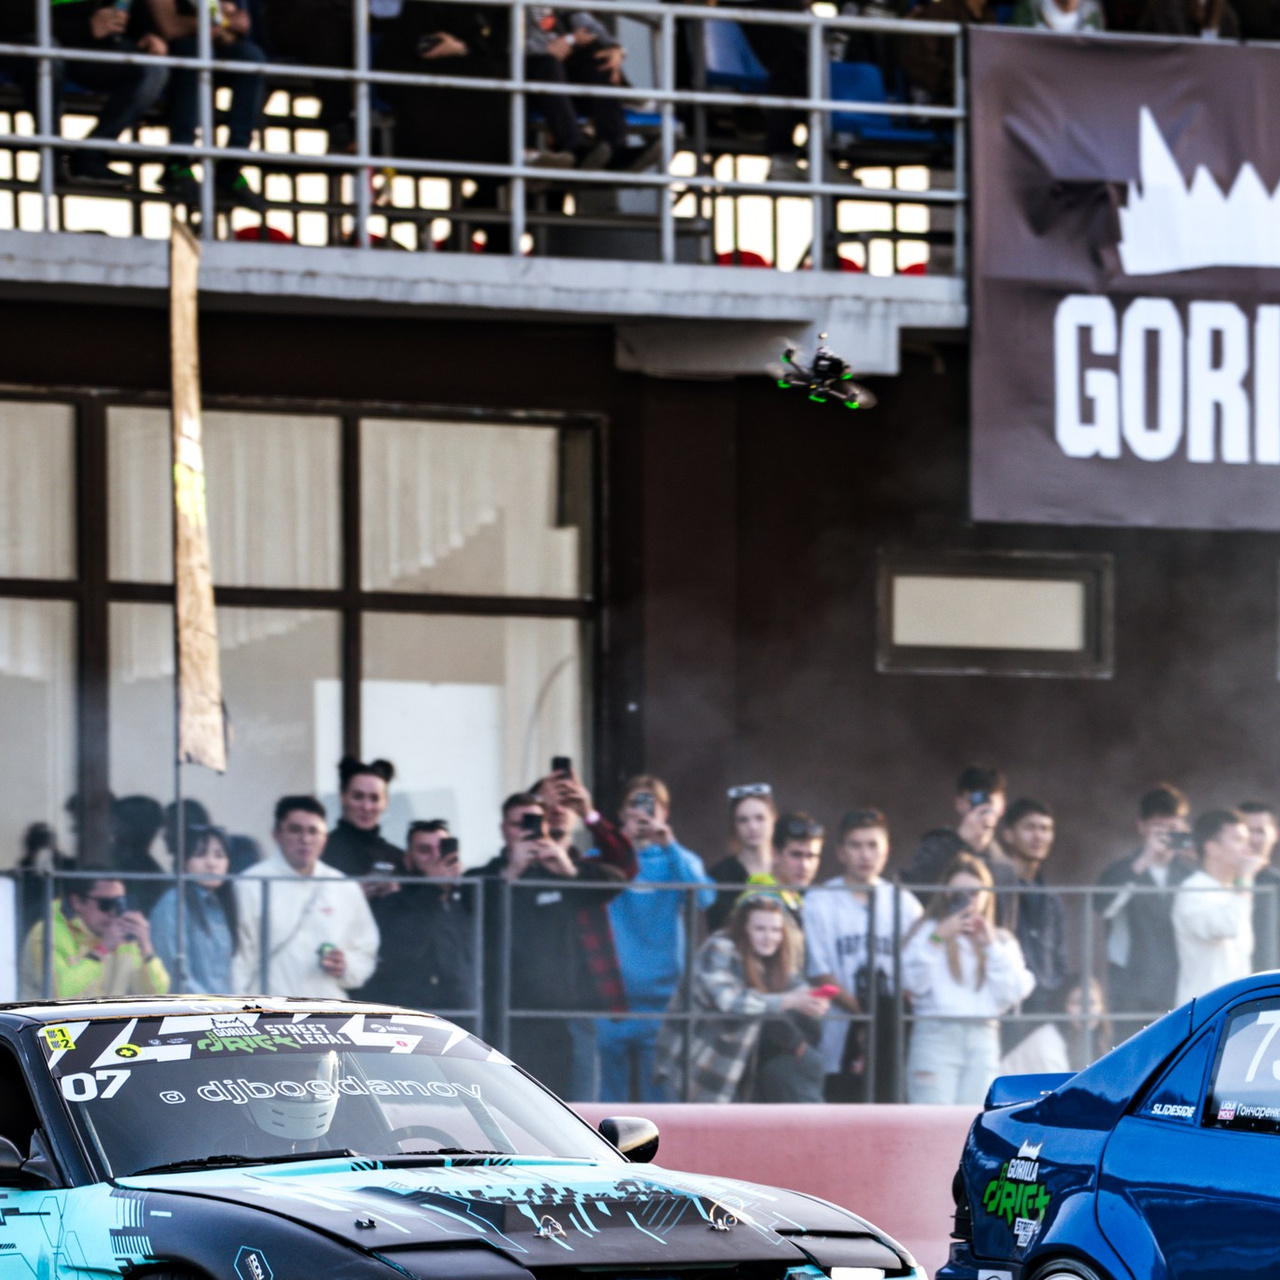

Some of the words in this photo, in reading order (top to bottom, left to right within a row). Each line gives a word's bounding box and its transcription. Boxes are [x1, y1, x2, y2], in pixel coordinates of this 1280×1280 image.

[57, 1029, 66, 1038] 1
[213, 1027, 262, 1038] GORILLA
[264, 1024, 332, 1035] STREET
[60, 1039, 72, 1048] 2
[293, 1034, 352, 1045] LEGAL
[61, 1069, 131, 1102] 07
[197, 1076, 482, 1104] djbogdanov
[1151, 1103, 1197, 1118] SLIDESIDE
[1007, 1158, 1040, 1182] GORILLA
